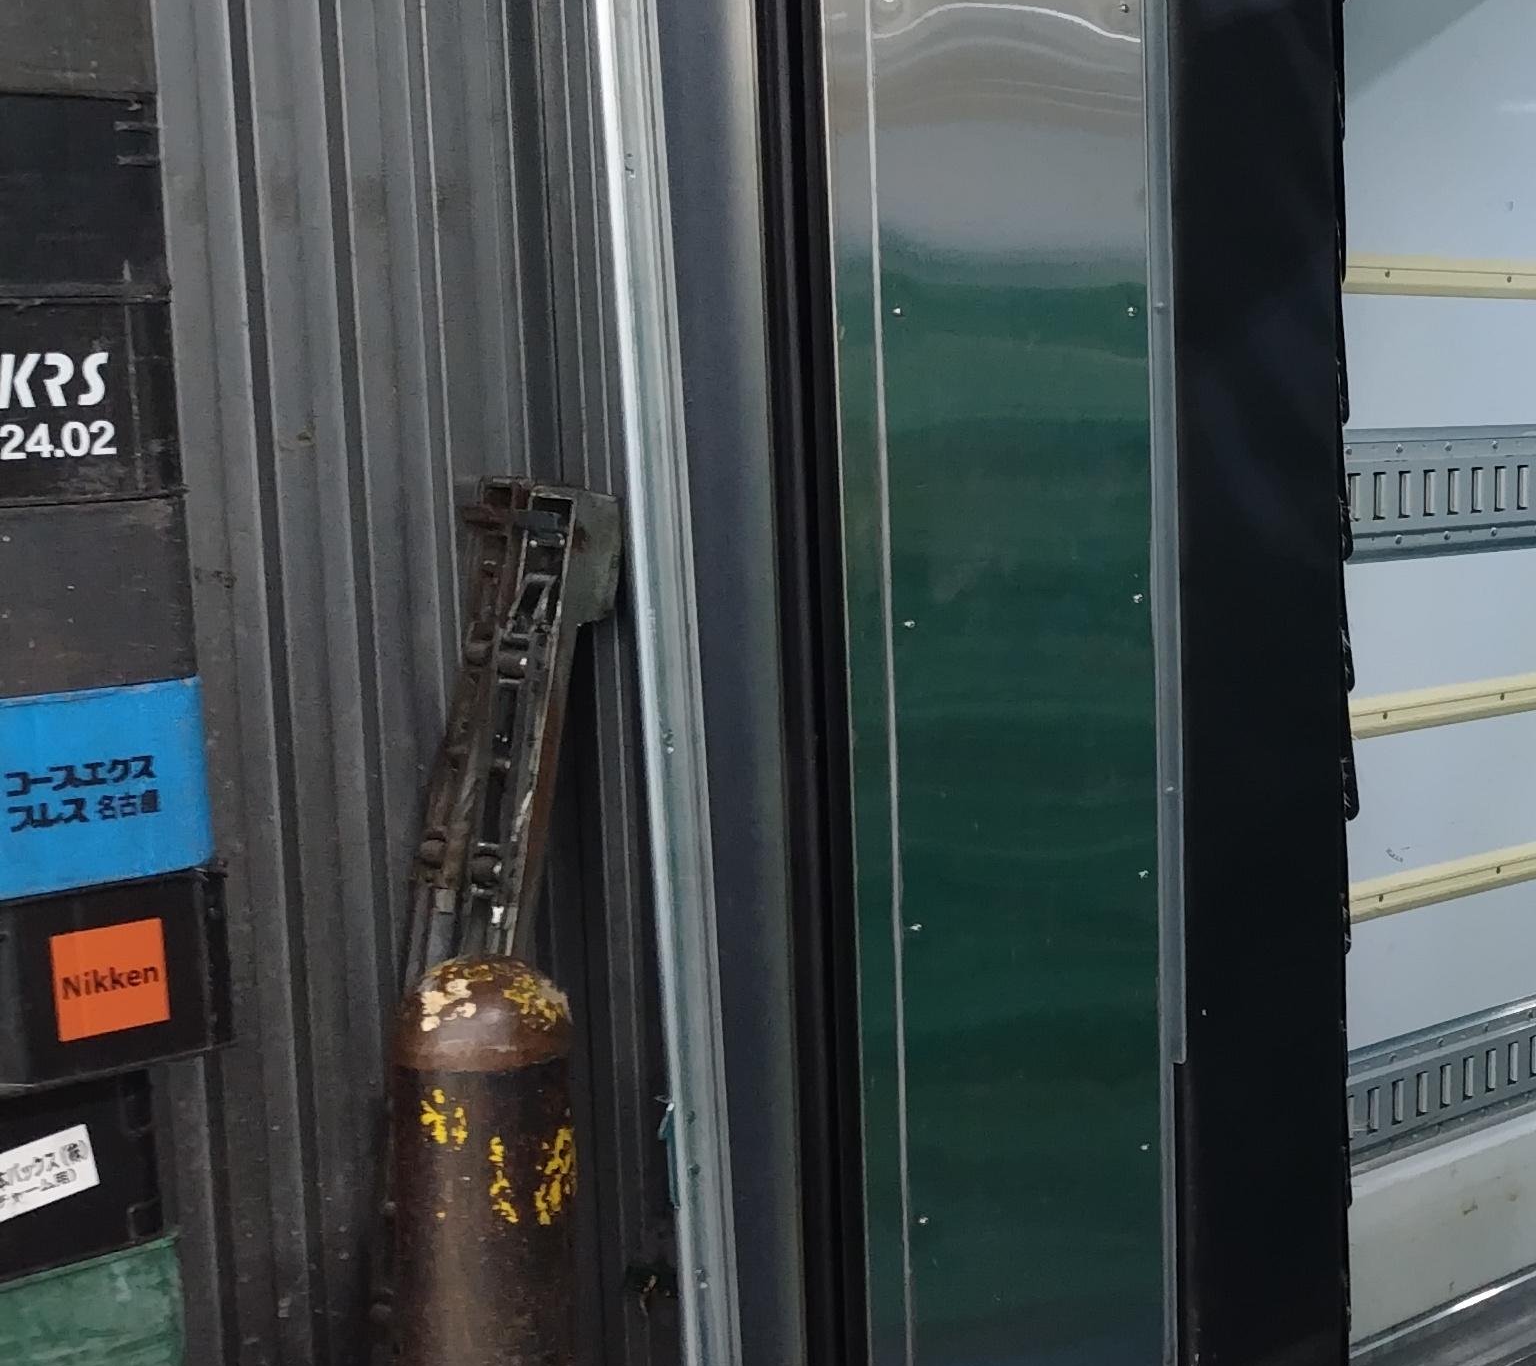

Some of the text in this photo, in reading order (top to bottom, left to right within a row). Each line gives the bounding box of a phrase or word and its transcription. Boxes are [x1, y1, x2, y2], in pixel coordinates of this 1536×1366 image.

[0, 351, 109, 409] KRS
[0, 420, 117, 460] 24.02
[60, 964, 160, 1000] Nikken
